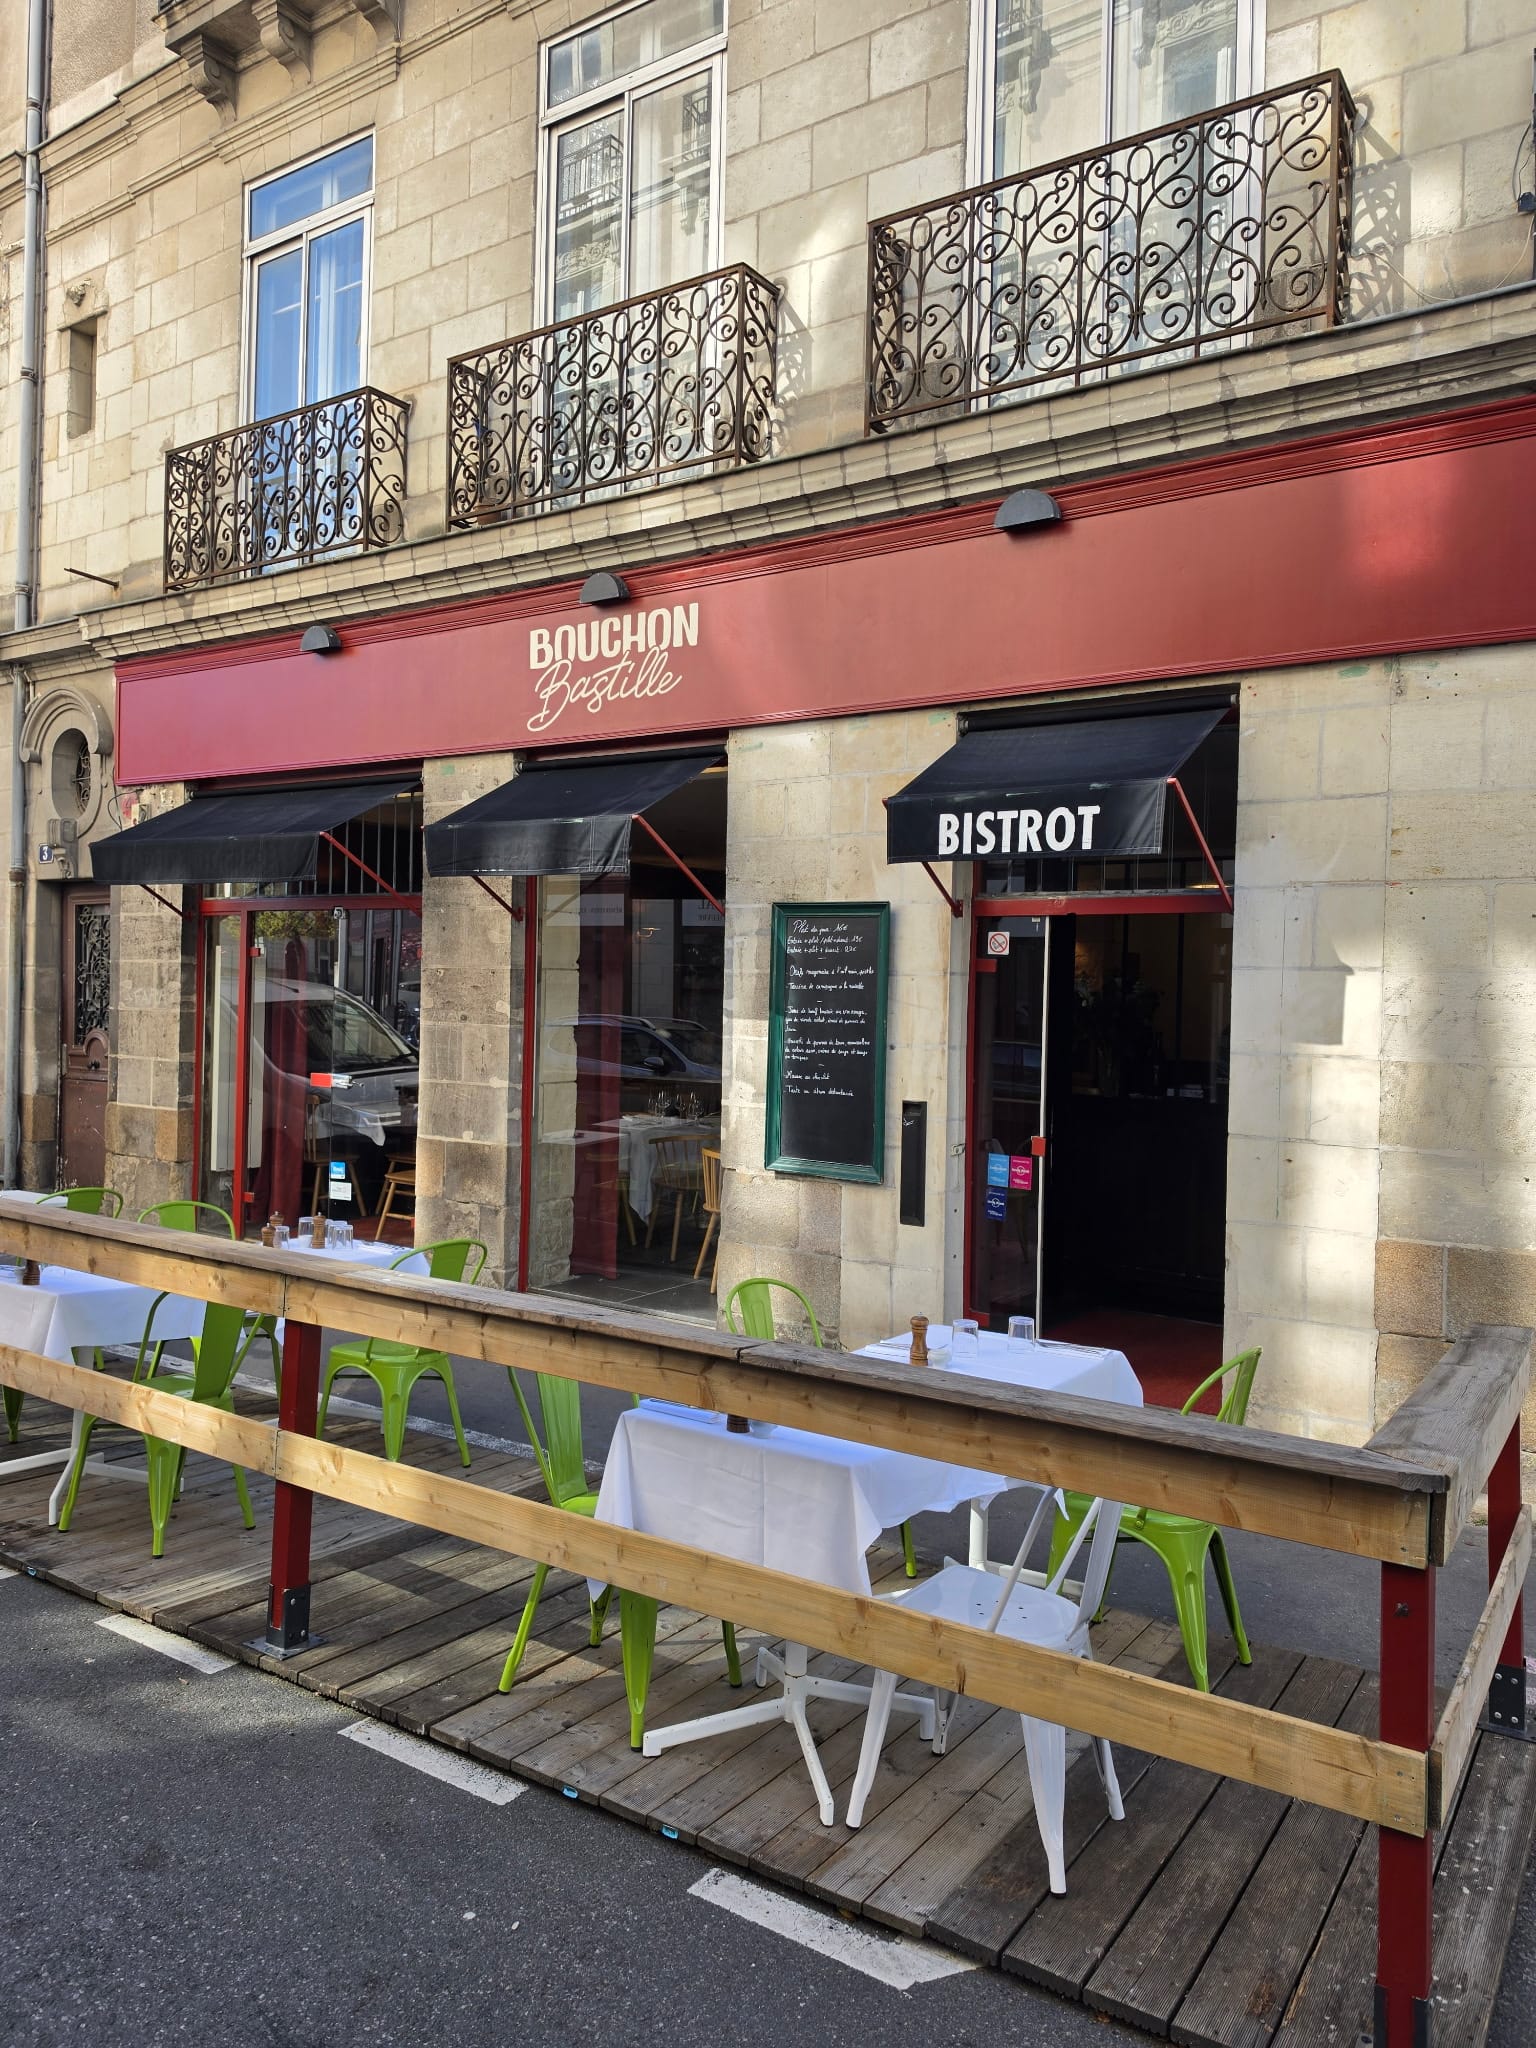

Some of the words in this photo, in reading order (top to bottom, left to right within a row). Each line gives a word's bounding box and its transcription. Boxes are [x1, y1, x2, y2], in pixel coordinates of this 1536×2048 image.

[529, 603, 699, 669] BOUCHON
[527, 646, 682, 732] Bastille
[42, 846, 48, 861] 3
[938, 805, 1101, 855] BISTROT
[833, 923, 848, 932] 16€
